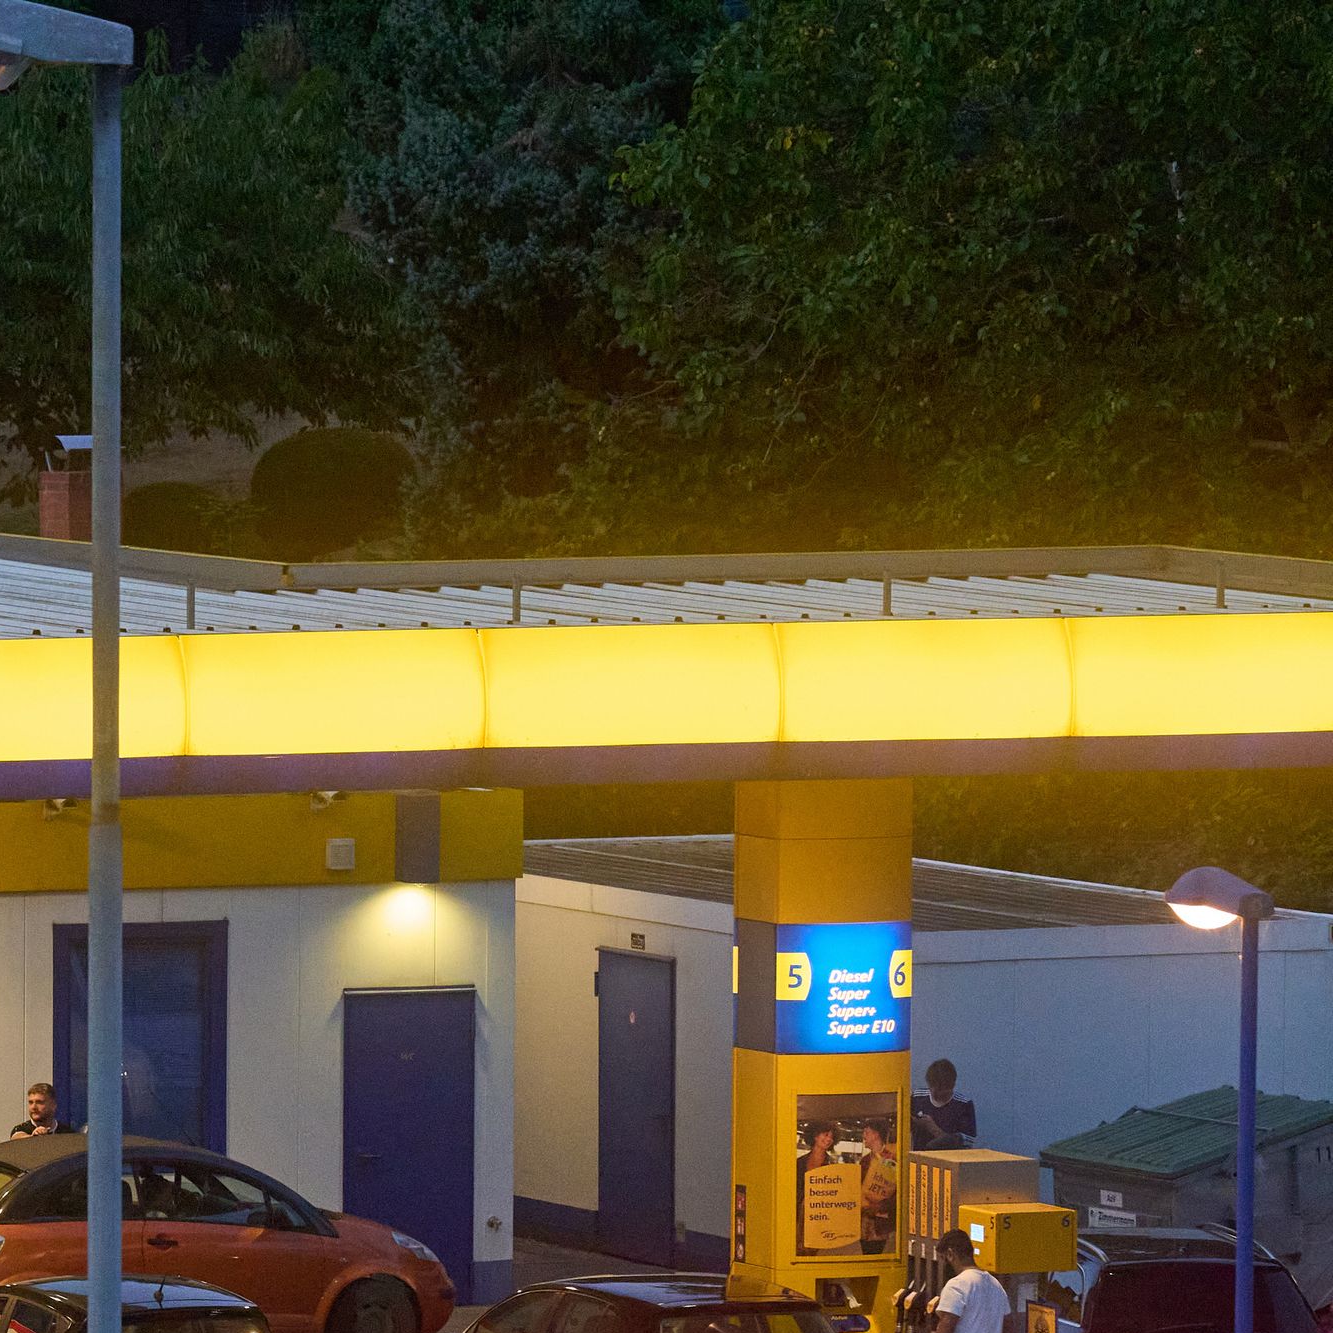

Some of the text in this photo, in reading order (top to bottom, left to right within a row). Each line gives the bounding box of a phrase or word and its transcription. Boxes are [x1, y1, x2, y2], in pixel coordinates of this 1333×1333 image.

[788, 965, 802, 988] 5
[828, 967, 874, 983] Diesel
[894, 961, 906, 986] 6
[827, 987, 870, 1004] Super
[827, 1004, 877, 1021] Super+
[827, 1019, 895, 1039] Super E10
[809, 1175, 842, 1184] Einfach
[809, 1188, 838, 1197] besser
[809, 1200, 857, 1210] unterwegs
[809, 1213, 830, 1221] sein.
[1003, 1216, 1011, 1230] 5
[1061, 1214, 1071, 1228] 6
